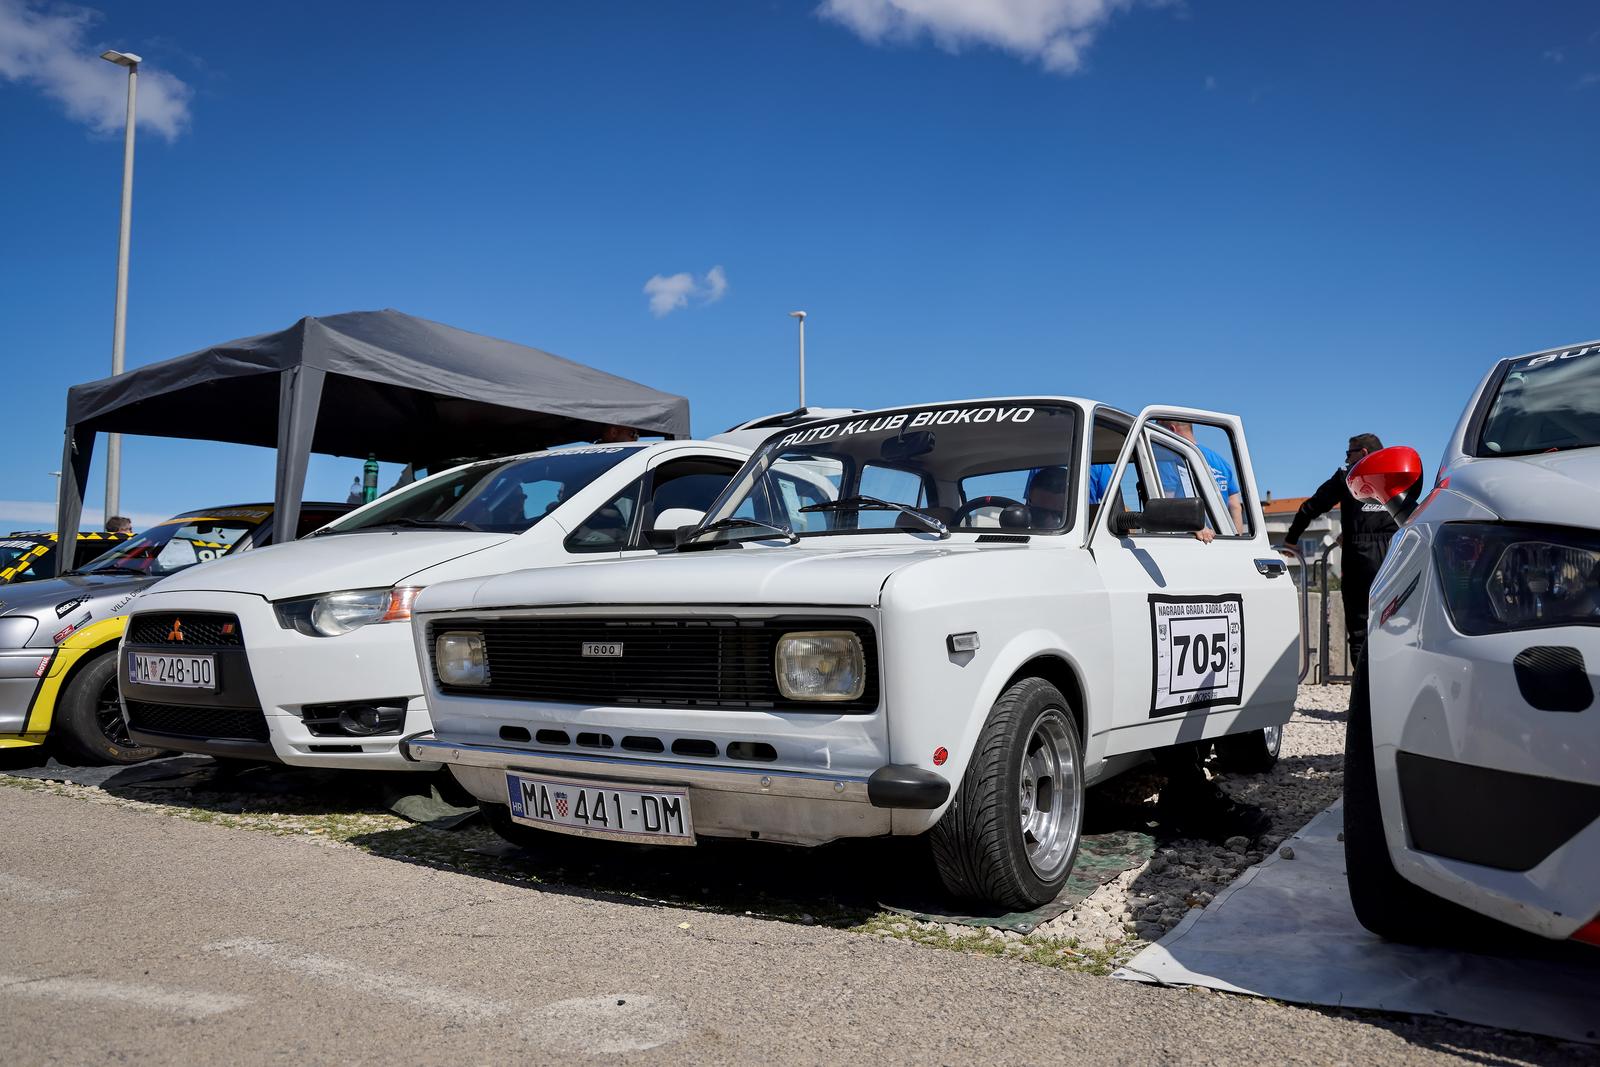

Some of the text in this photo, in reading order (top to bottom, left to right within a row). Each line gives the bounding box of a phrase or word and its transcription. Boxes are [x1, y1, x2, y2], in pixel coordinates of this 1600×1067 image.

[776, 408, 1035, 449] AUTO KLUB BIOKOVO
[111, 596, 131, 612] VILLA
[1159, 603, 1237, 616] NAGRADA GRADA ZADRA 2024
[588, 645, 615, 655] 1600
[1173, 633, 1227, 676] 705
[36, 656, 51, 676] MOTUL
[136, 656, 150, 681] MA
[512, 801, 523, 813] HR
[522, 781, 555, 821] MA
